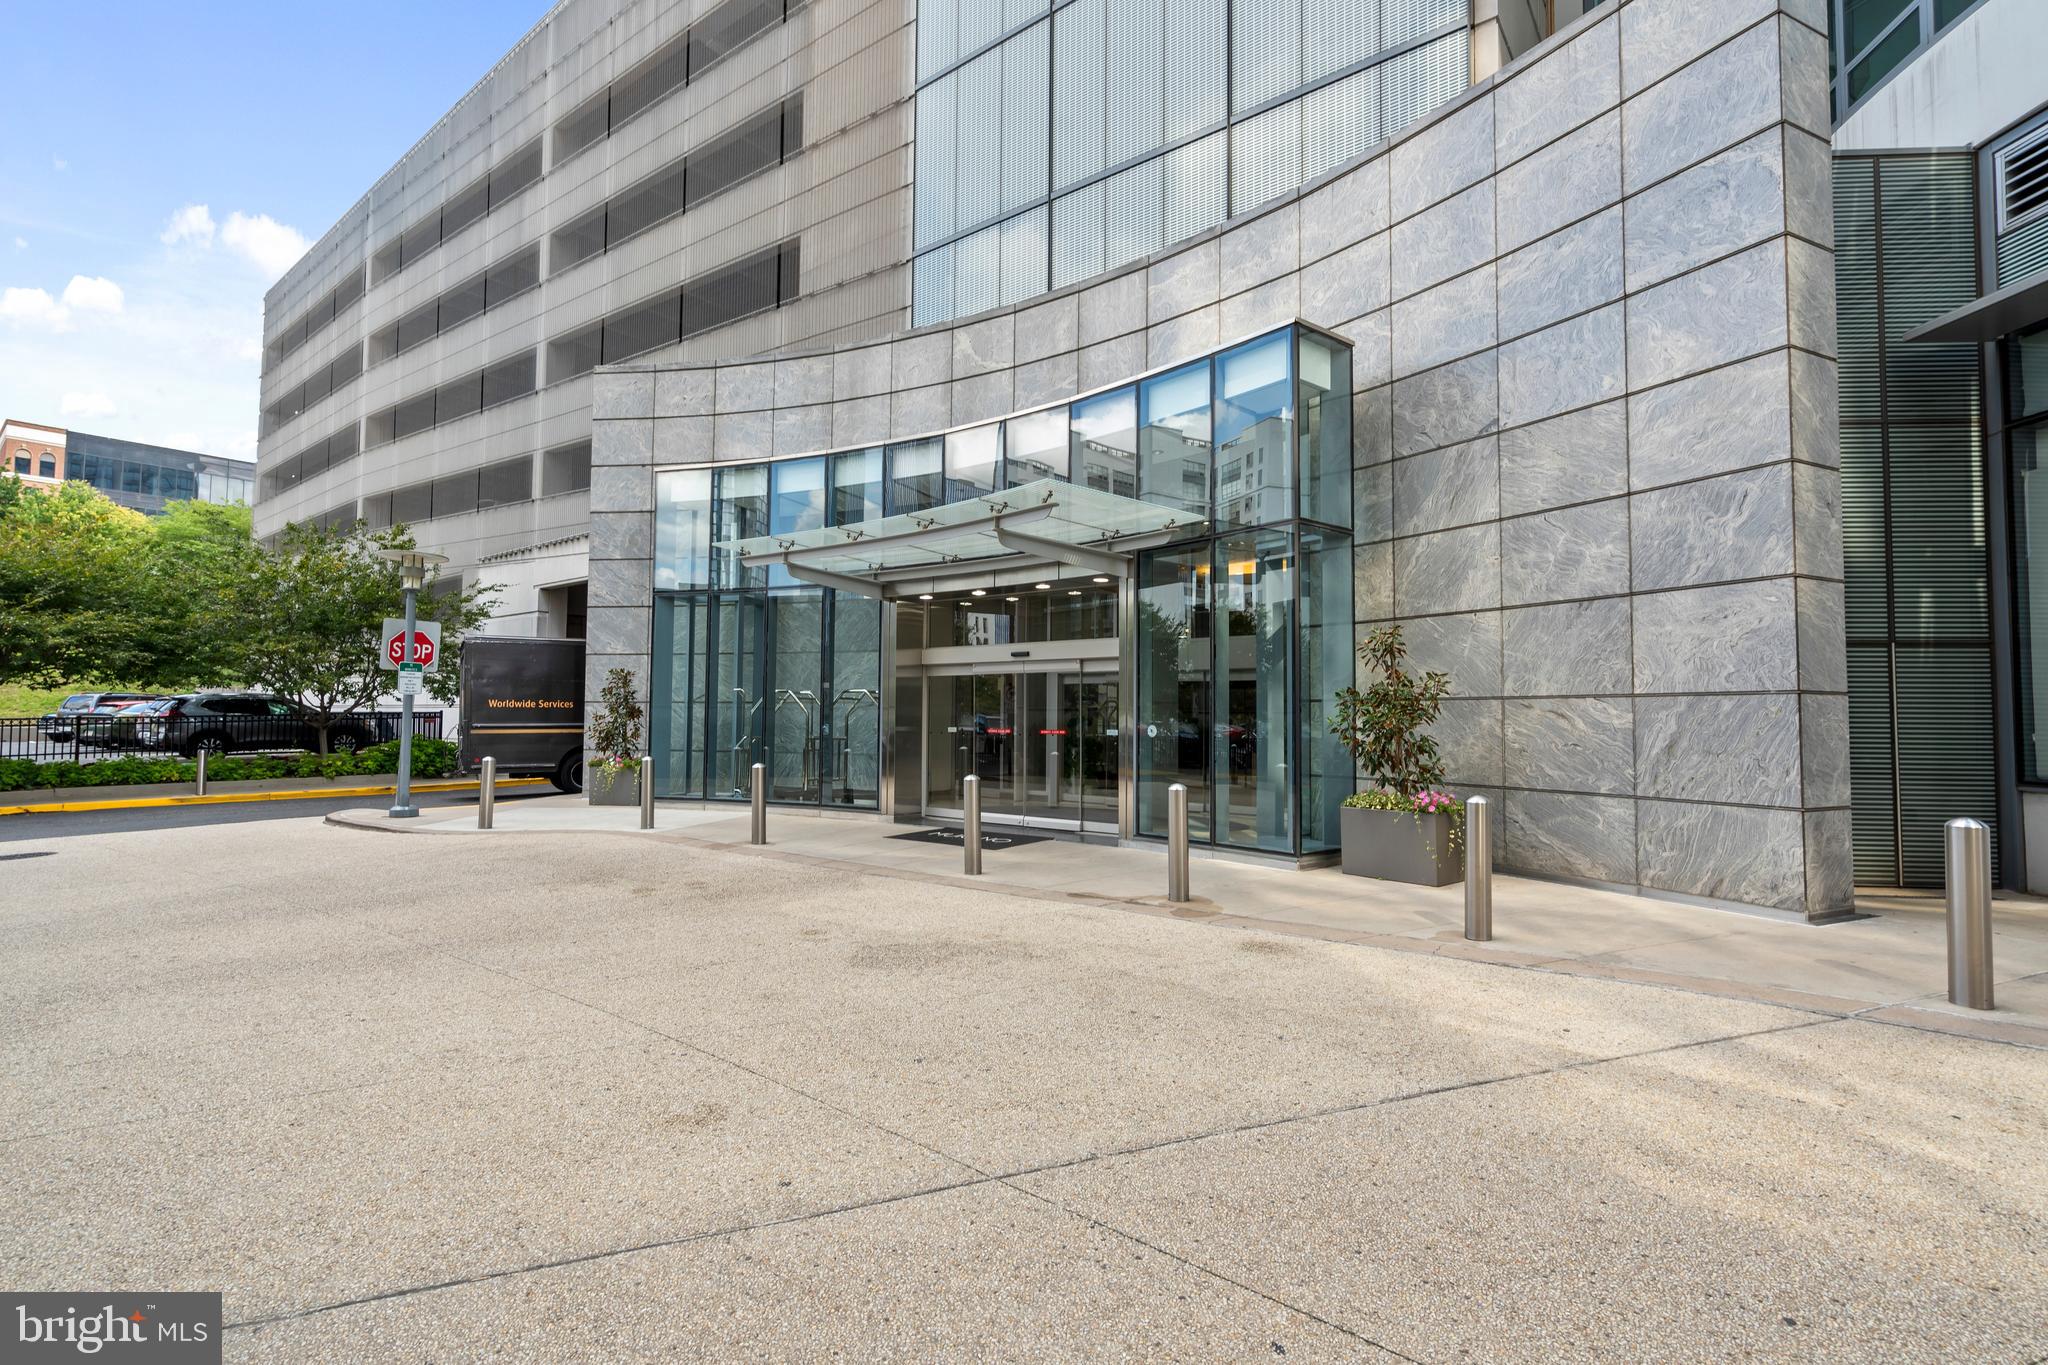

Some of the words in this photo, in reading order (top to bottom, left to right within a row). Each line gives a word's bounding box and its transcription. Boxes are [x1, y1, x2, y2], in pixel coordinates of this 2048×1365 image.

[391, 642, 432, 659] SOP
[488, 699, 536, 708] Worldwide
[538, 699, 574, 708] Services
